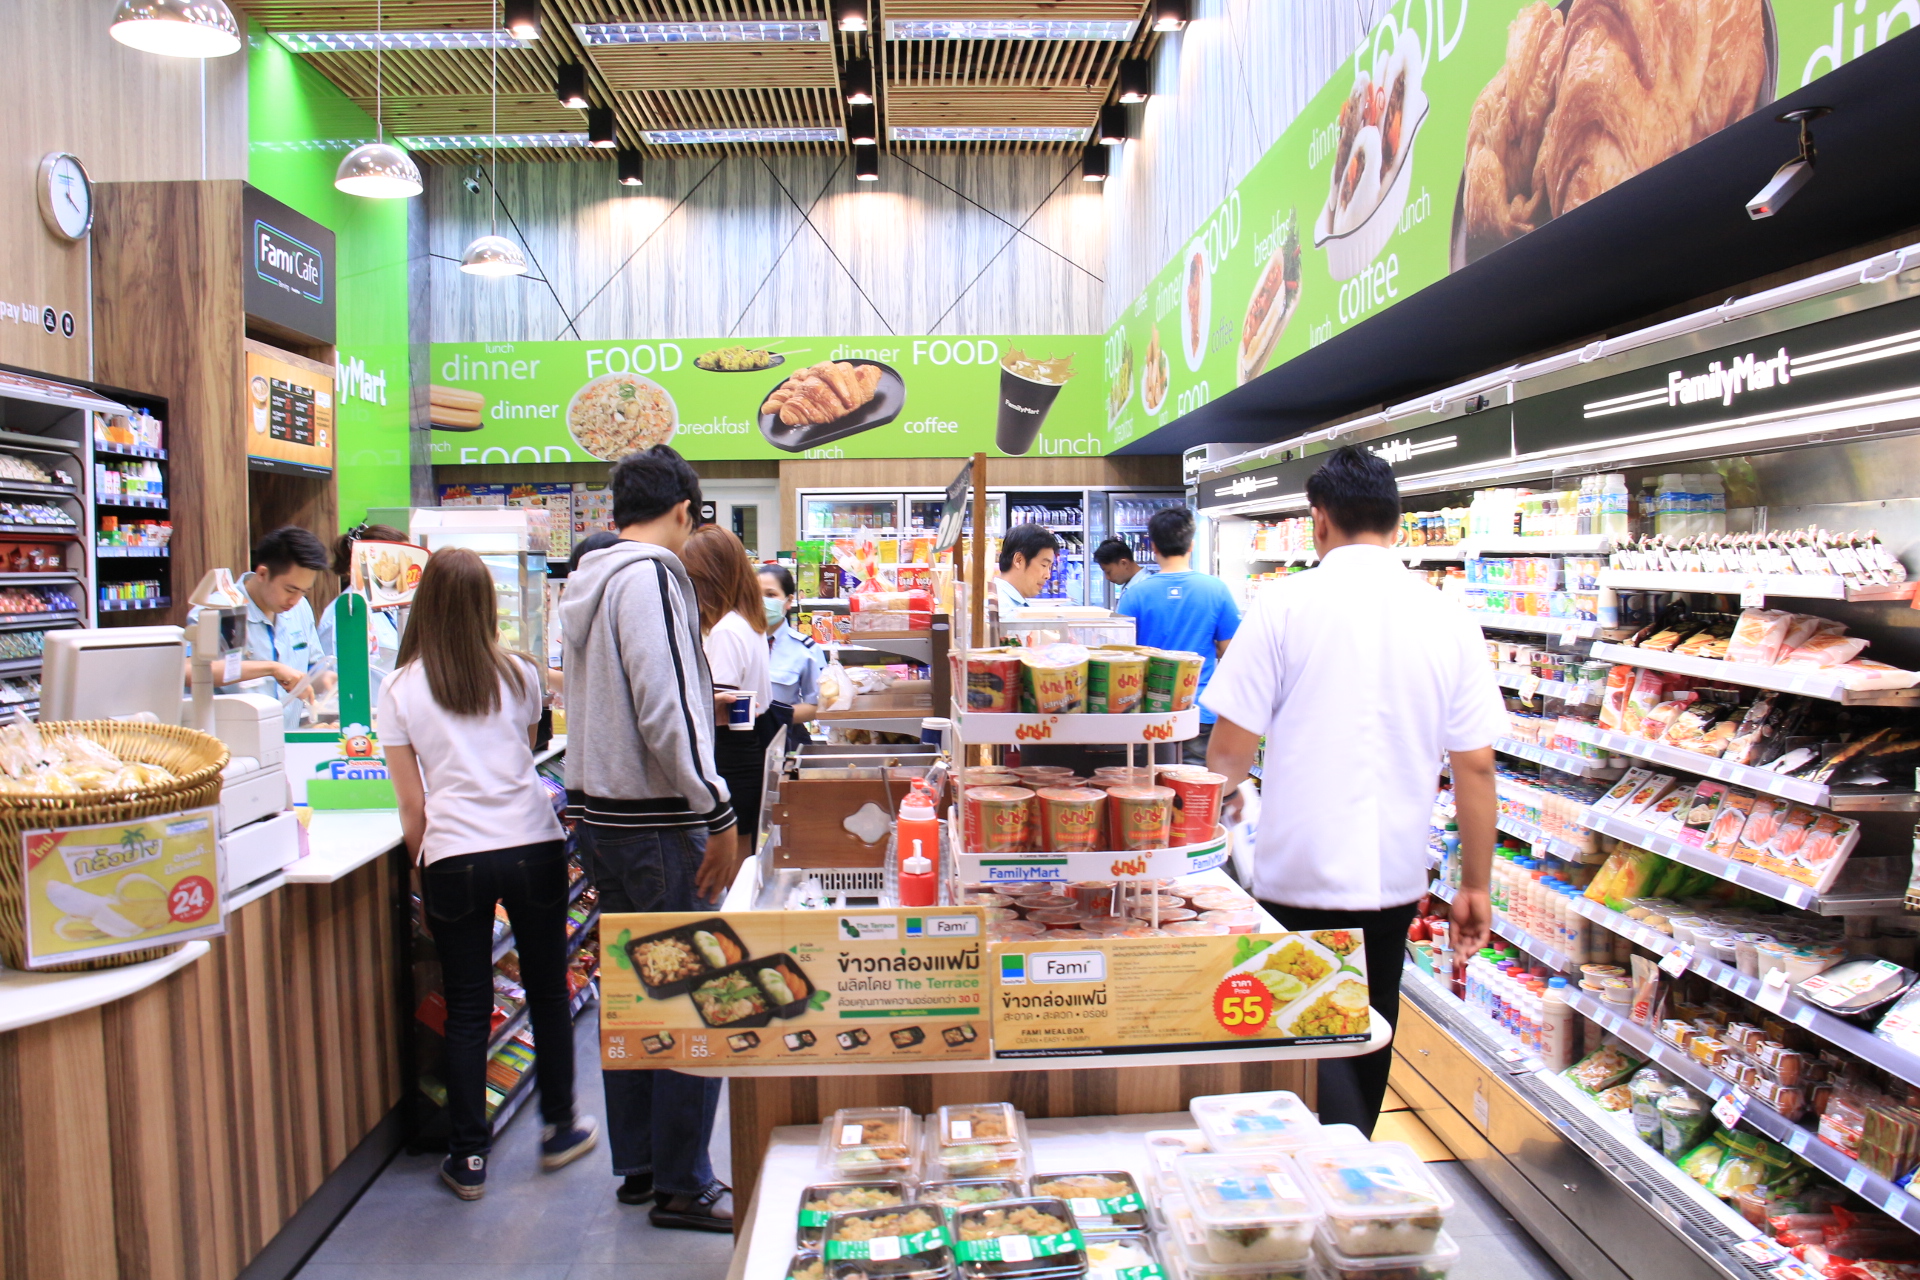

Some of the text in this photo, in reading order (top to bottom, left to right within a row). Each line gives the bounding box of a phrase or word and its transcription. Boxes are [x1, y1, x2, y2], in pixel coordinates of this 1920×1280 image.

[1308, 115, 1341, 170] dinne
[1202, 190, 1241, 275] OOD
[1254, 209, 1292, 267] breakfas
[261, 233, 319, 286] Fami Cafe
[1156, 272, 1183, 322] dinner
[0, 301, 39, 325] pay bill
[1211, 316, 1234, 354] coffee
[485, 343, 514, 355] lunch
[586, 343, 683, 378] FOOD
[830, 344, 900, 362] dinner
[913, 340, 998, 365] FOOD
[442, 354, 541, 381] dinner
[1668, 347, 1790, 407] FamilyMart
[491, 400, 559, 419] dinner
[1005, 399, 1039, 415] FamilyMart
[904, 417, 959, 434] coffee
[1039, 433, 1101, 455] lunch
[407, 569, 418, 583] 27
[331, 762, 391, 780] Fam
[989, 867, 1060, 880] FamilyMart
[937, 921, 968, 932] Fami
[837, 942, 980, 972] ข้าวกล่องแฟมี่
[1047, 960, 1091, 975] Fami
[837, 976, 979, 991] ผลิตโดย The Terrace
[958, 995, 971, 1003] 30
[1002, 984, 1107, 1008] ข้าวกล่องแฟมี่
[1222, 996, 1265, 1026] 55
